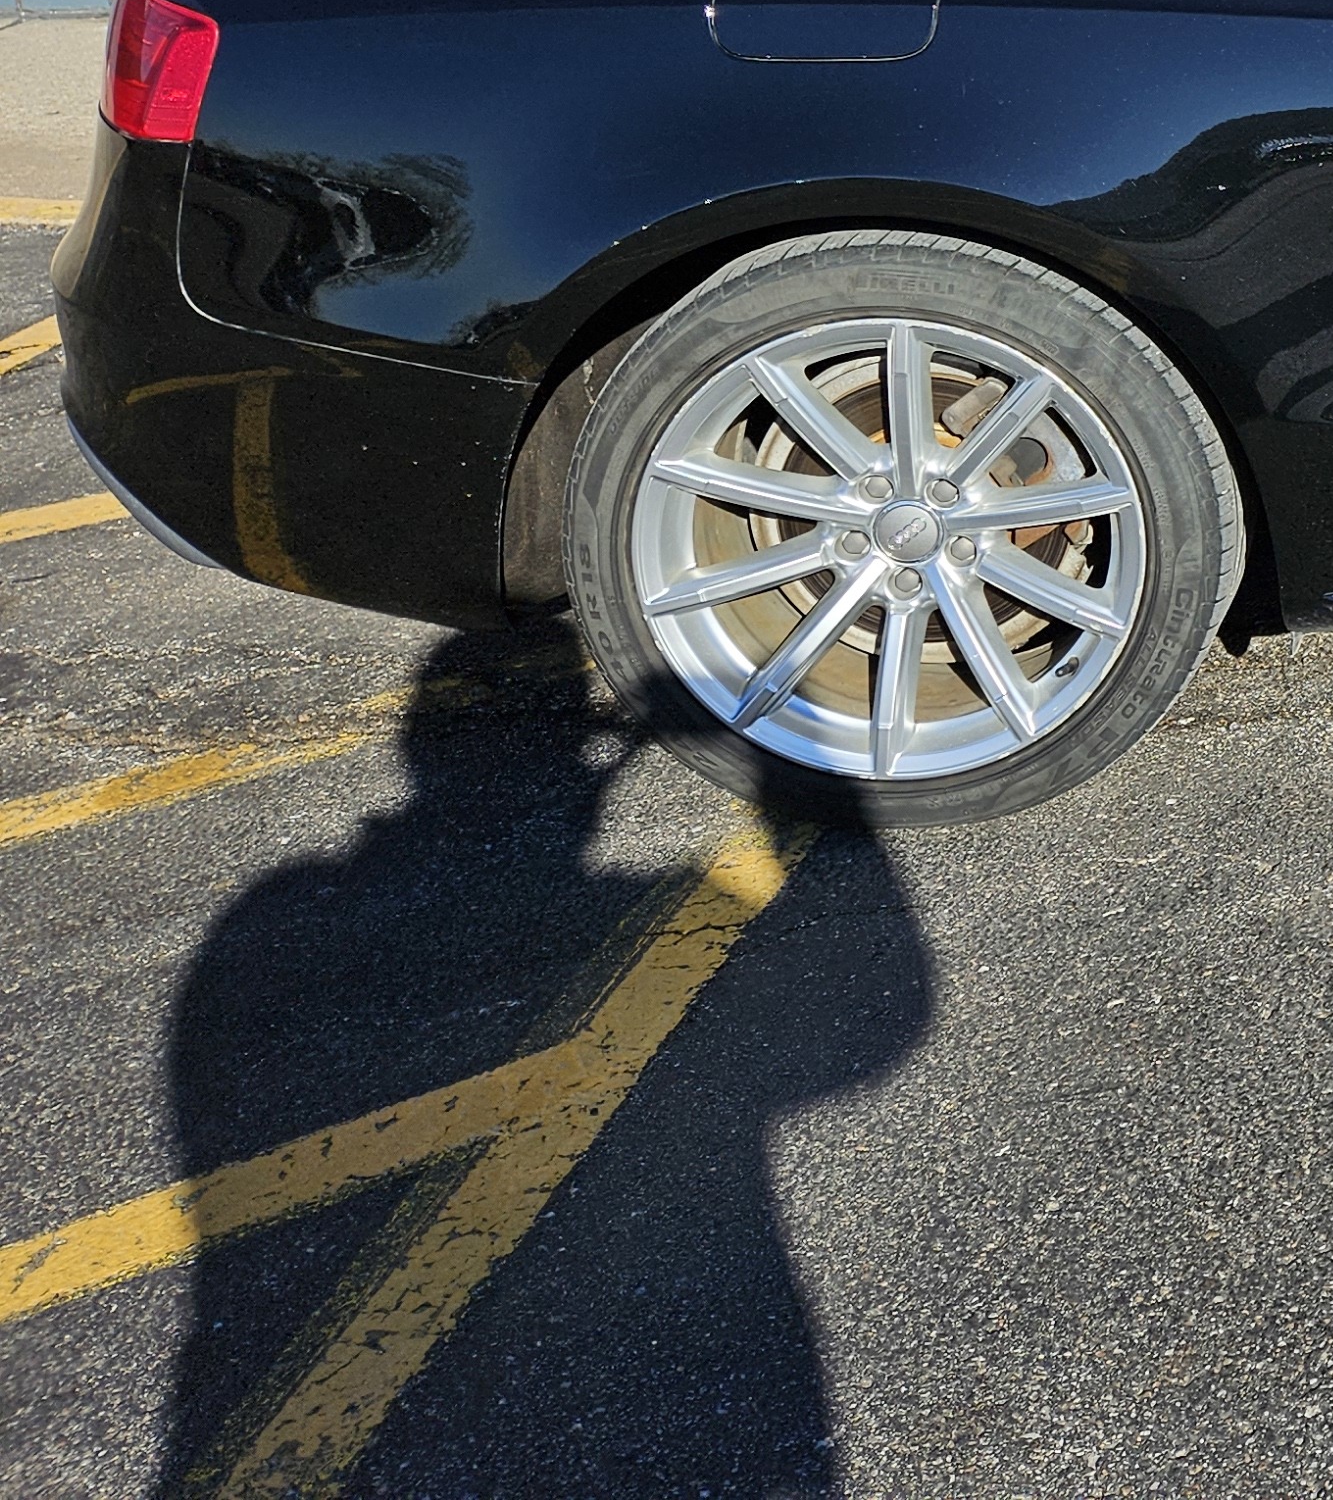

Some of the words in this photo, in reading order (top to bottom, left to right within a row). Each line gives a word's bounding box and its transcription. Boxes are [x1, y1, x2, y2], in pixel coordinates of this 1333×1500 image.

[1120, 586, 1195, 720] Cinturato
[1134, 626, 1157, 668] ALL
[1067, 672, 1136, 749] SEASON
